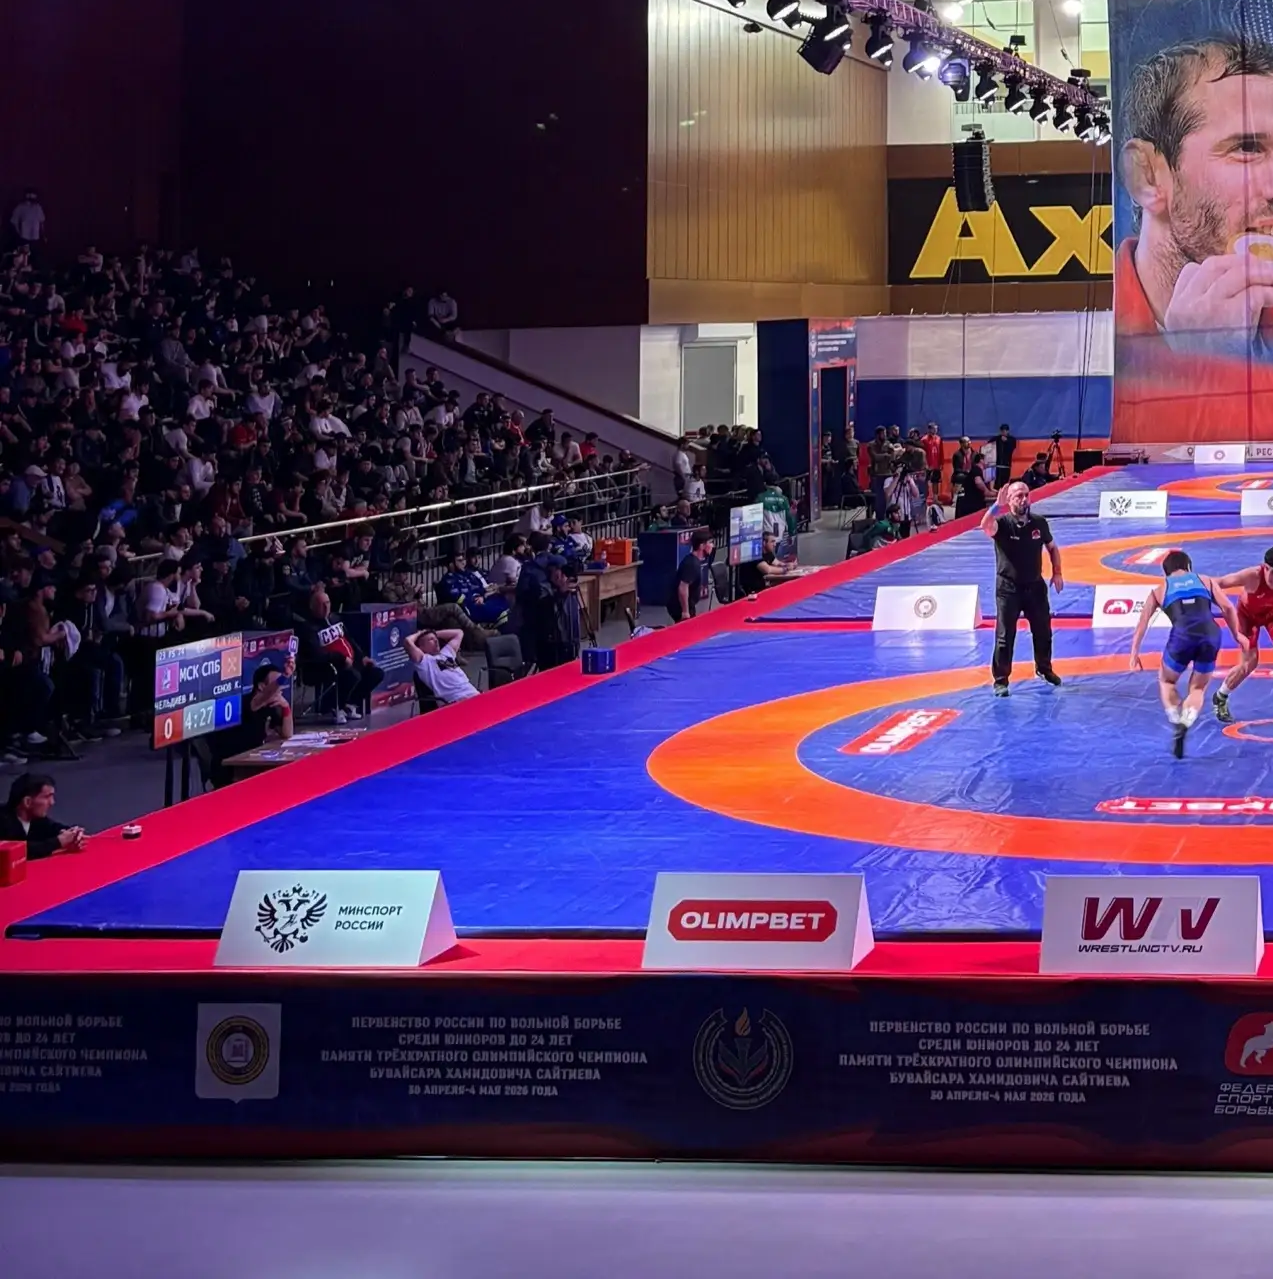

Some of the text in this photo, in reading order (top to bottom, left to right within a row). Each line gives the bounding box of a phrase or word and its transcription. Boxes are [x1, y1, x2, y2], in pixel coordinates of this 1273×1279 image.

[180, 659, 220, 682] МСК СПБ
[213, 682, 232, 695] СЕНОВ
[184, 706, 213, 730] 4:27
[224, 701, 232, 722] 0
[164, 718, 172, 739] 0
[338, 906, 402, 916] МИНСПОРТ
[334, 920, 384, 930] РОССИИ
[680, 911, 826, 930] OLIMPBET
[1078, 944, 1203, 953] WRESTLINGTV.RU
[869, 1020, 1151, 1035] ПЕРВЕНСТВО РОССИИ ПО ВОЛЬНОЙ БОРЬБЕ
[917, 1038, 1101, 1052] СРЕДИ ЮНИОРОВ ДО 24 ЛЕТ
[838, 1053, 892, 1066] ПАМЯТИ
[995, 1055, 1101, 1069] ОЛИМПИЙСКОГО
[1105, 1057, 1179, 1070] ЧЕМПИОНА
[888, 1071, 1130, 1086] БУВАЙСАРА ХАМИДОВИЧА САЙТИЕВА
[1003, 1090, 1026, 1101] МАЯ
[1029, 1091, 1055, 1102] 2026
[1057, 1091, 1087, 1103] ГОДА
